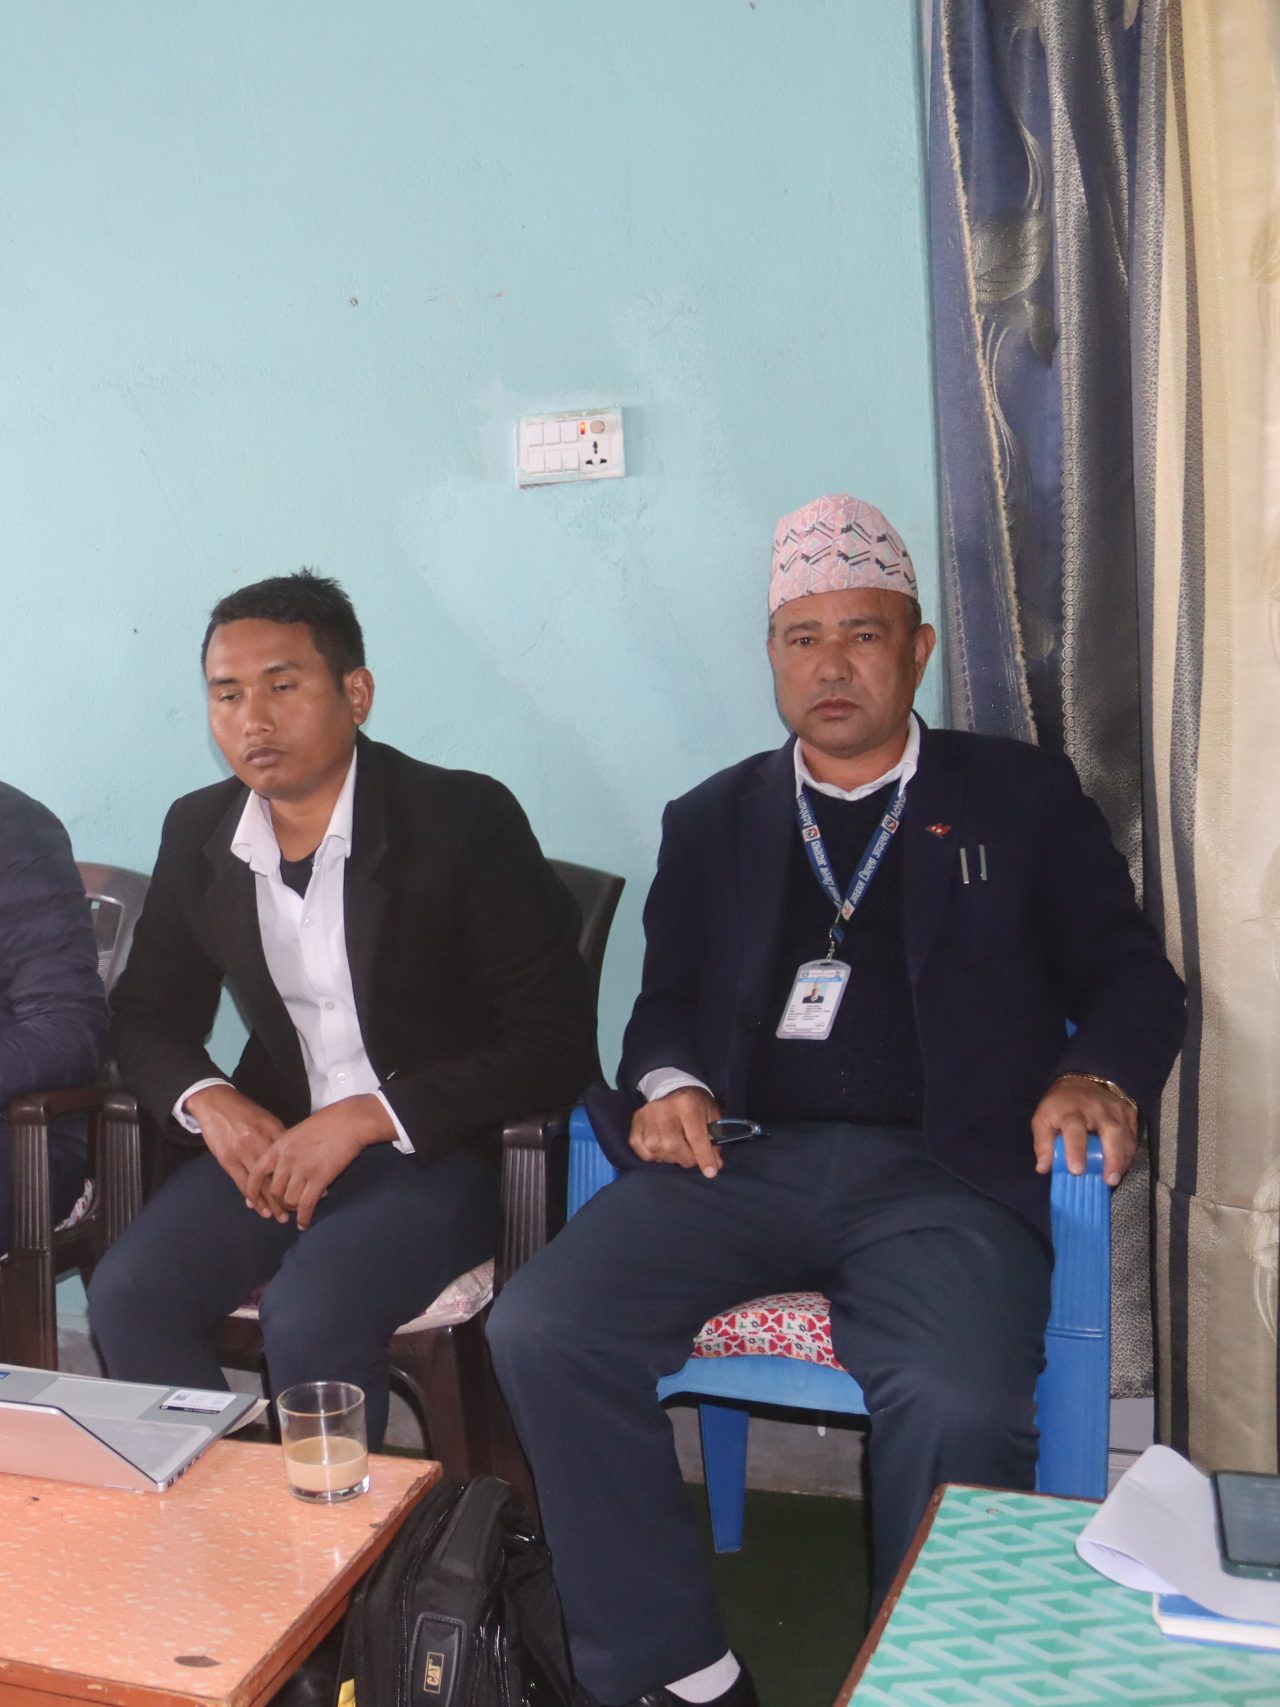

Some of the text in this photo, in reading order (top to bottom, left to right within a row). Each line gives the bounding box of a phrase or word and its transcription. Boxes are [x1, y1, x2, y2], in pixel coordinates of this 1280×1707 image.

[796, 795, 814, 827] Achham
[871, 831, 891, 858] अदालत
[427, 1658, 440, 1686] CAT
